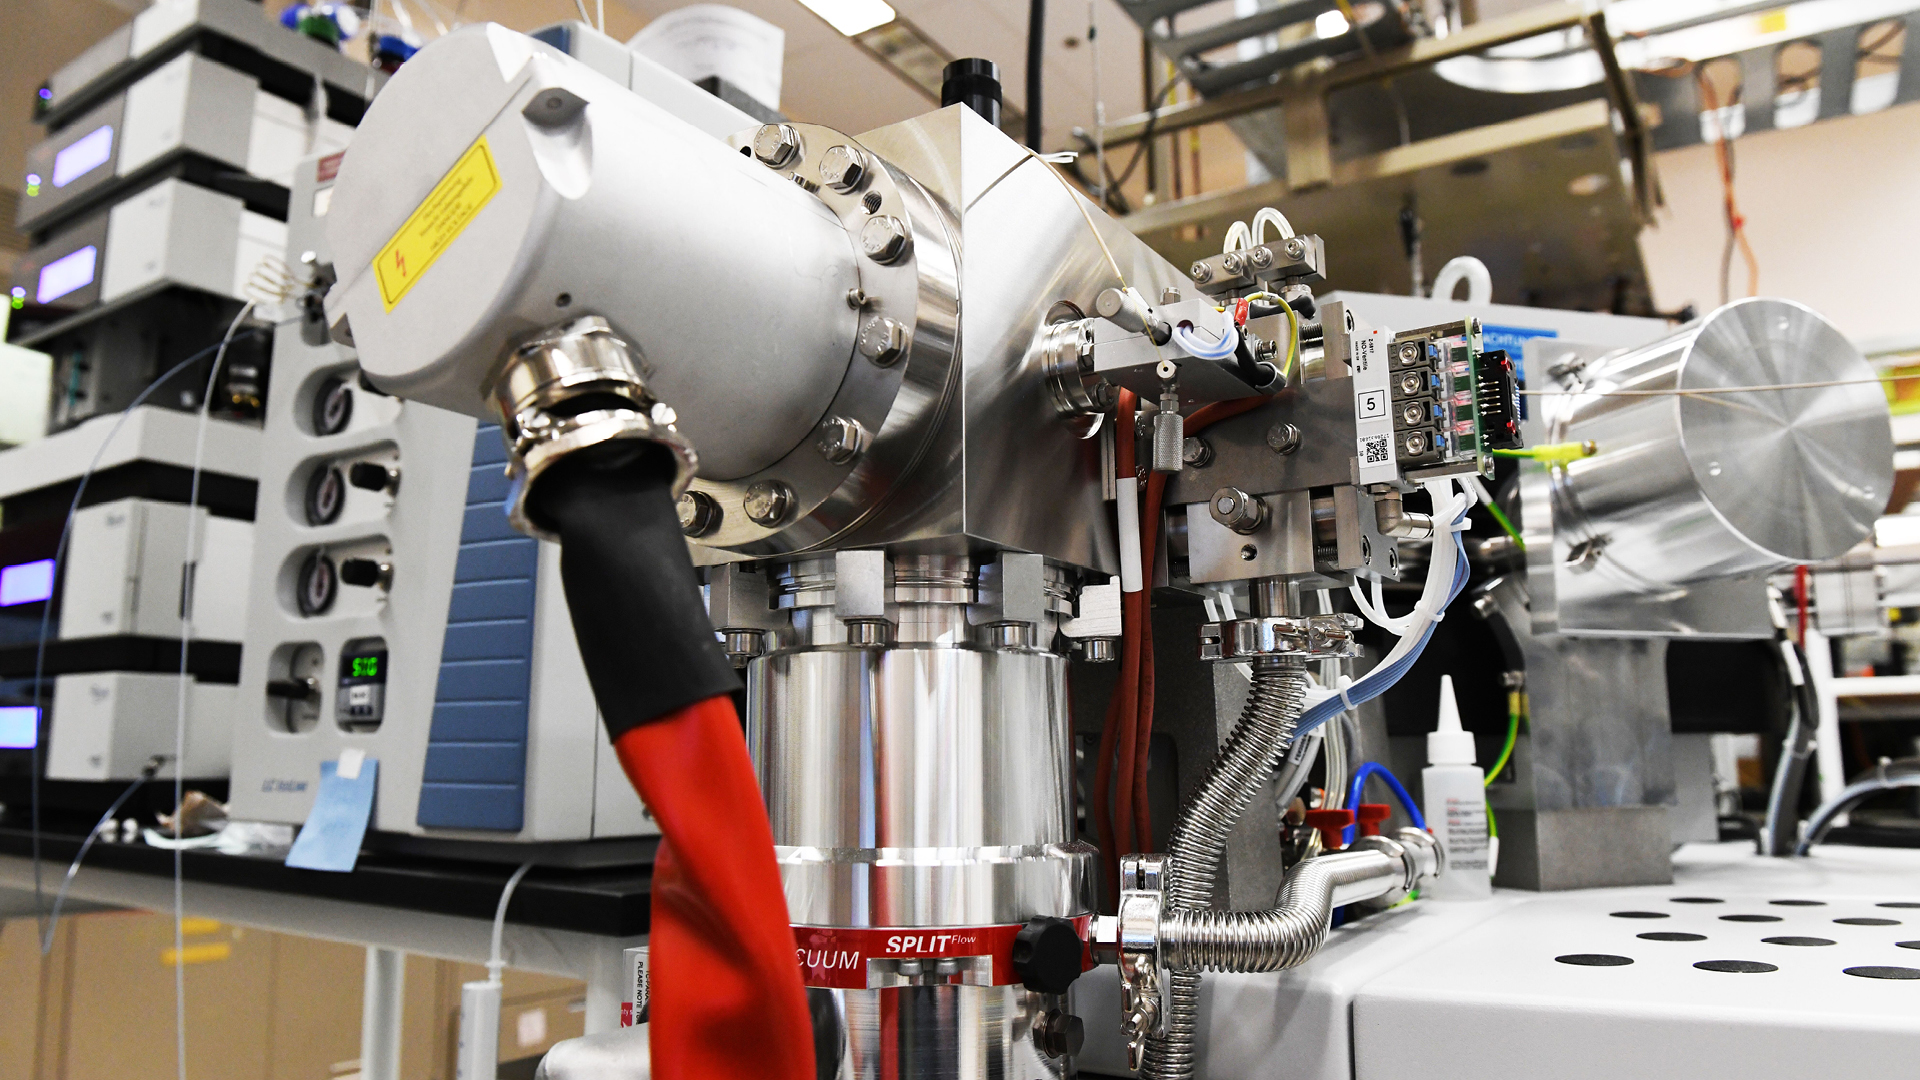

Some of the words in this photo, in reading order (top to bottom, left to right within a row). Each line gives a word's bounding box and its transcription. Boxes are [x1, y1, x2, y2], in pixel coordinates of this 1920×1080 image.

[1366, 397, 1376, 411] 5
[885, 935, 951, 953] SPLIT
[951, 934, 976, 945] Flow
